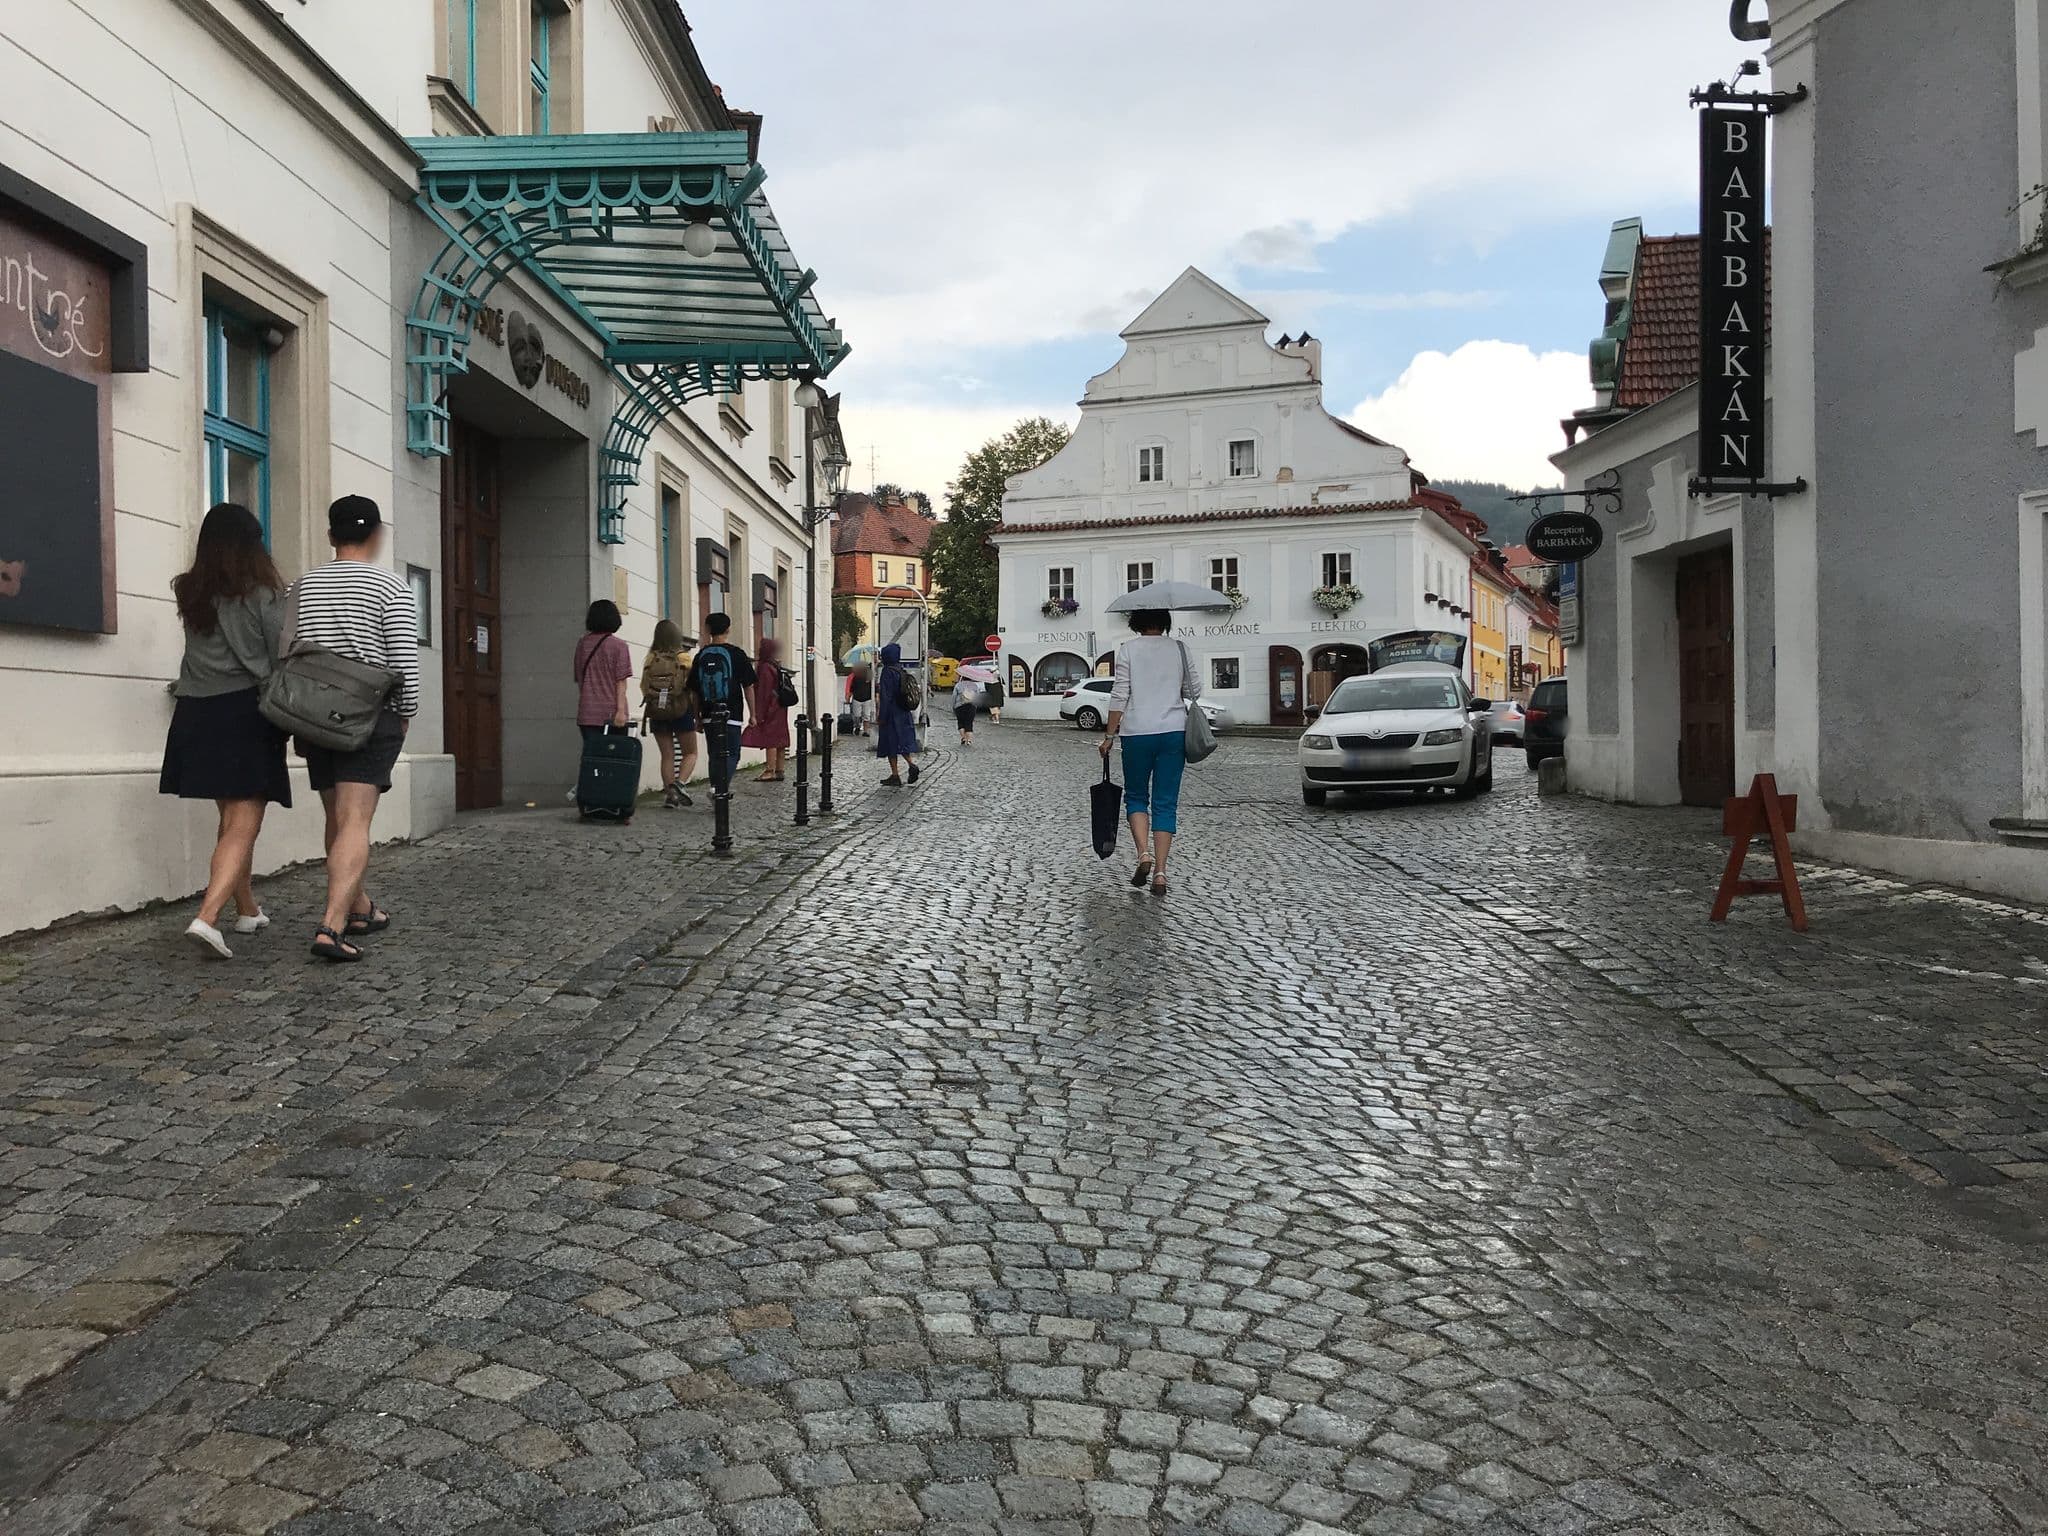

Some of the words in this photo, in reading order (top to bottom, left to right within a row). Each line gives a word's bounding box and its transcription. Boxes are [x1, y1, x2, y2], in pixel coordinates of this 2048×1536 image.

[1721, 121, 1751, 466] BARBAKÁN
[0, 252, 103, 358] ntré
[1544, 525, 1585, 537] Reception
[1536, 536, 1593, 548] BARBAKÁN
[1311, 619, 1367, 632] ELEKTRO
[1037, 631, 1088, 643] PENSION
[1178, 626, 1196, 638] NA
